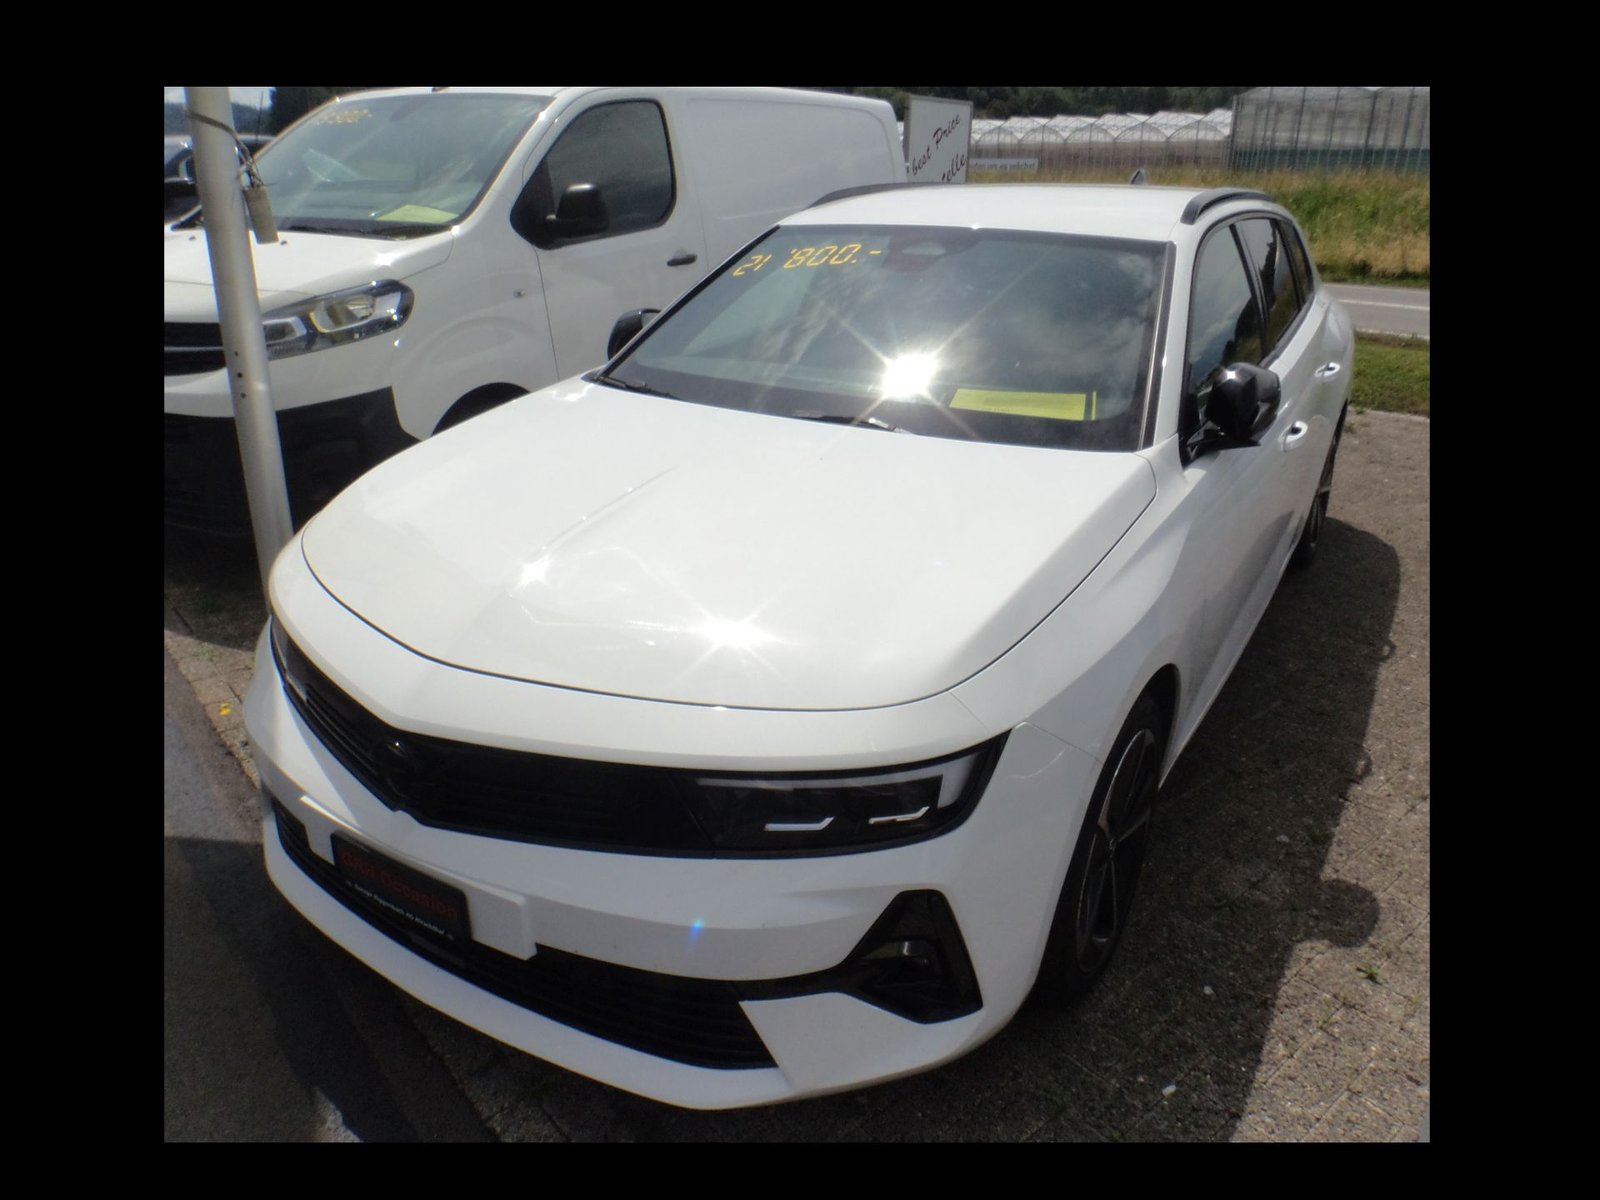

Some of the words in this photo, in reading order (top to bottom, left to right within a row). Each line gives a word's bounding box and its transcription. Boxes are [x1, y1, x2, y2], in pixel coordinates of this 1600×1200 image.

[912, 145, 932, 176] best
[933, 113, 961, 149] Price
[732, 254, 772, 276] 21
[381, 870, 457, 918] Occasion
